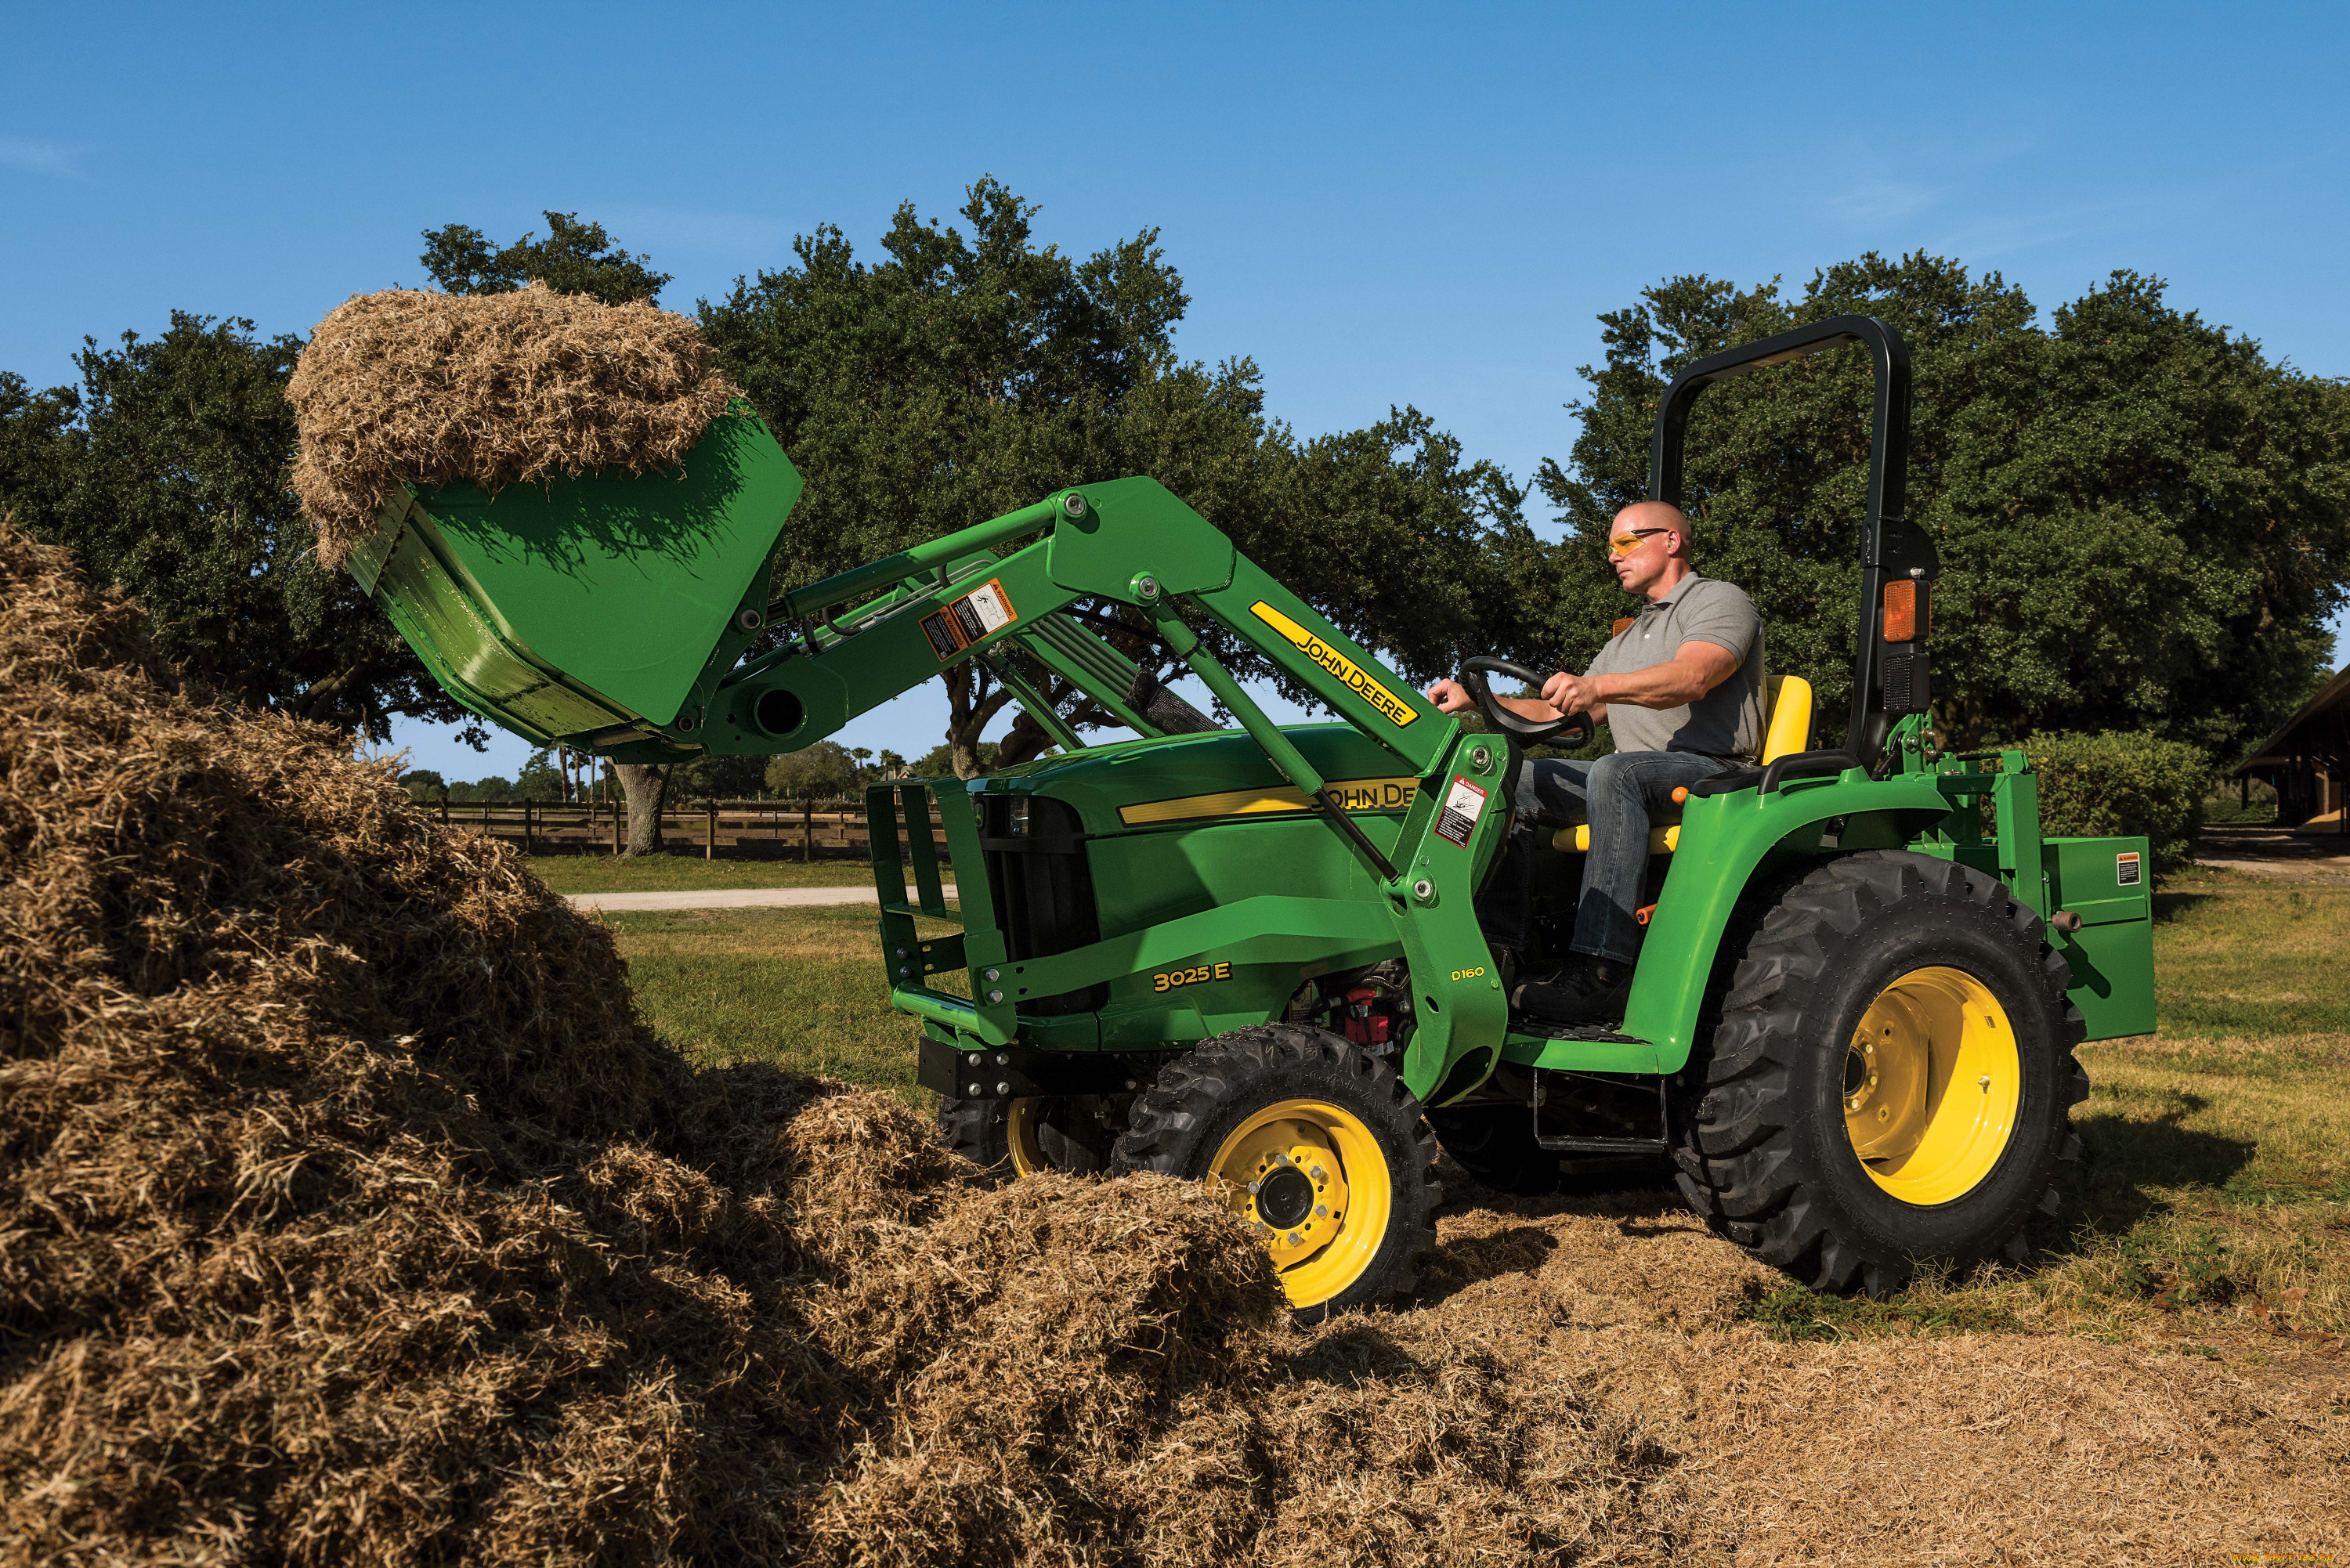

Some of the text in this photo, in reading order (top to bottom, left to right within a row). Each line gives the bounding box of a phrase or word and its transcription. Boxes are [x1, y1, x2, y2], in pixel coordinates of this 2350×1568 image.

[996, 589, 1014, 616] WARNING
[946, 618, 964, 646] WARNING
[1296, 636, 1407, 724] JOHN DEERE
[1464, 782, 1484, 795] DANGER
[1153, 962, 1231, 992] 3025 E
[1452, 966, 1484, 981] D160
